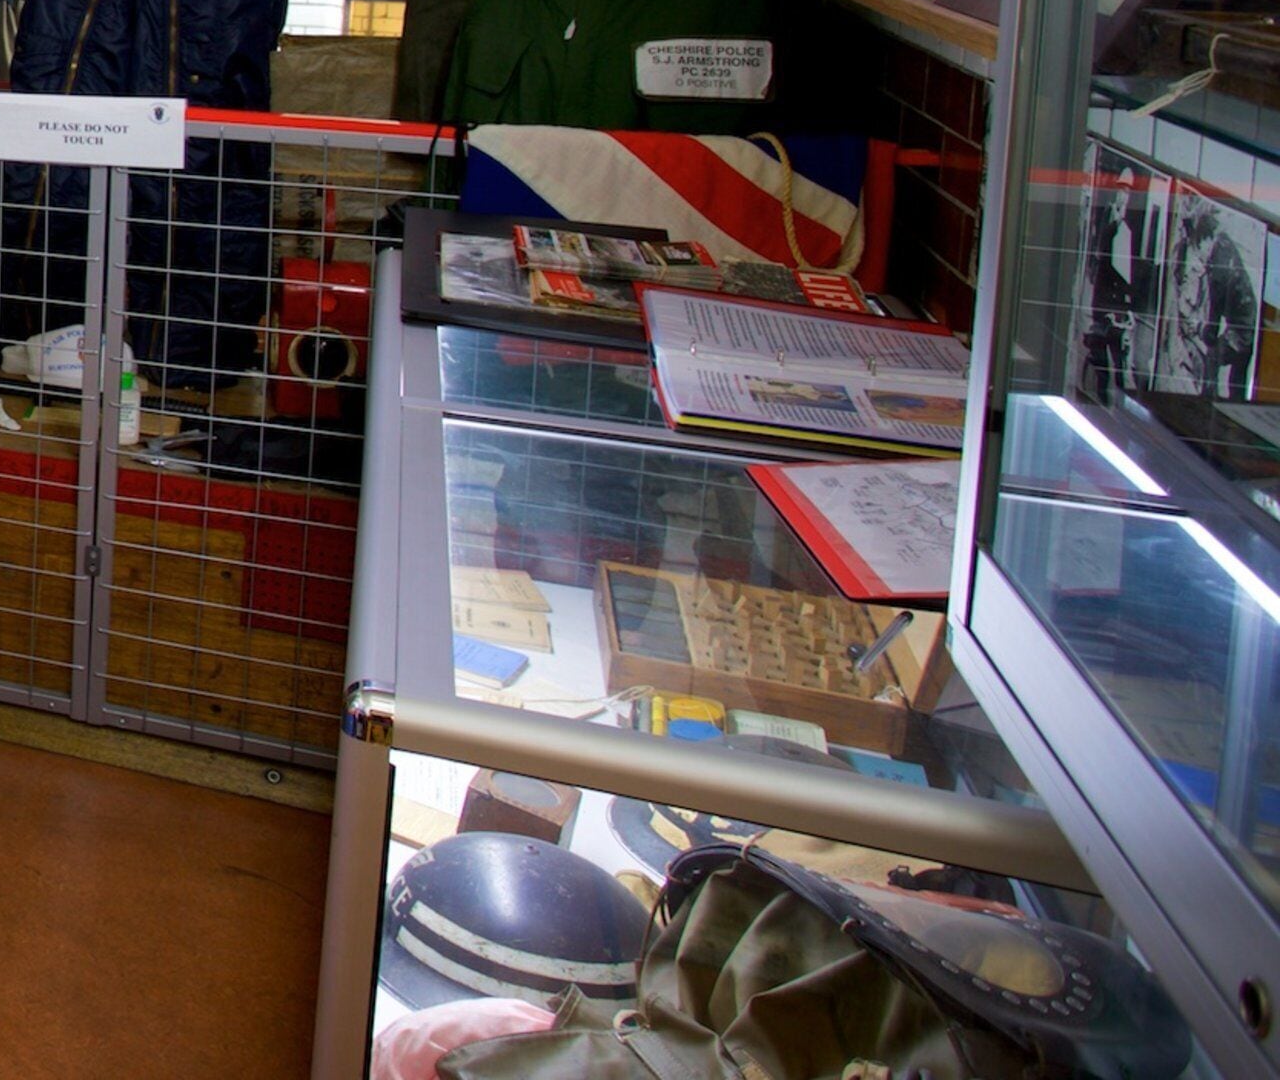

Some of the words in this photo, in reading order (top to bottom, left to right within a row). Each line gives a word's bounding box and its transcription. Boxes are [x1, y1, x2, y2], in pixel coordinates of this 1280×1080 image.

[648, 46, 714, 57] CHESHIRE
[716, 46, 765, 57] POLICE
[678, 56, 761, 67] ARMSTRONG
[681, 67, 699, 76] PC
[687, 79, 737, 89] POSITIVE
[39, 122, 81, 133] PLEASE
[84, 123, 101, 133] DO
[104, 124, 129, 134] NOT
[63, 135, 104, 146] TOUCH
[798, 272, 860, 311] LIFE
